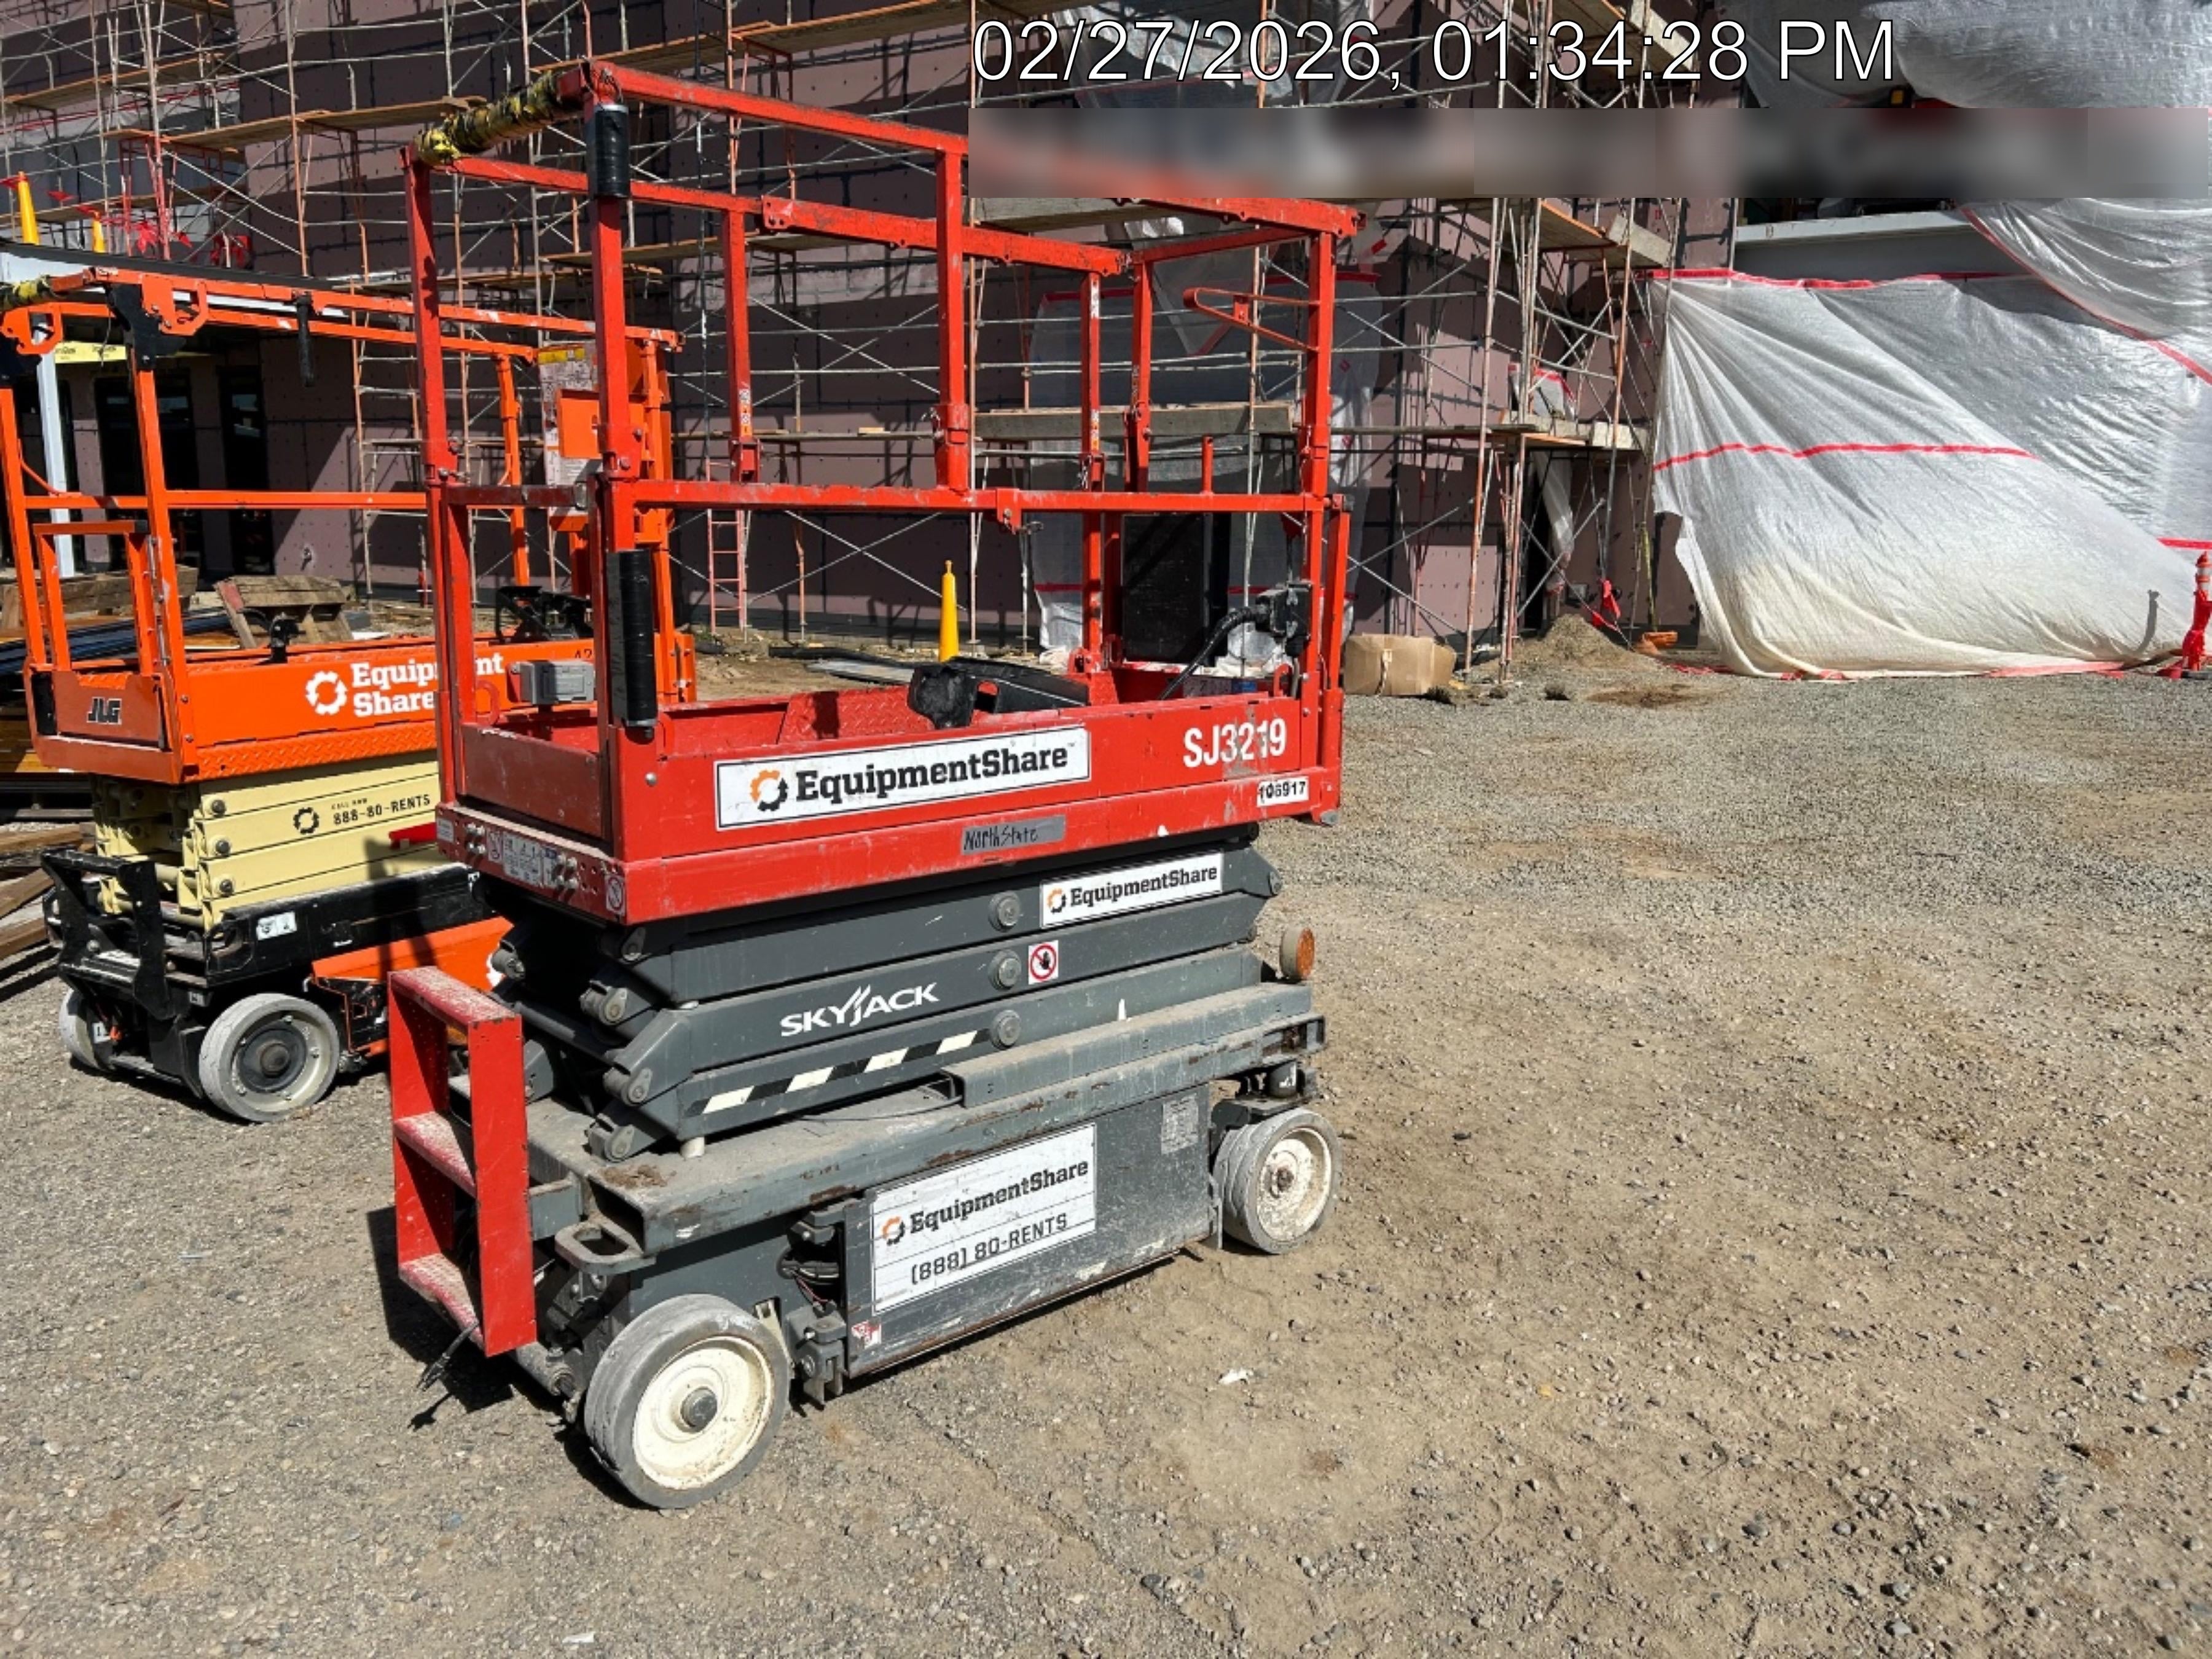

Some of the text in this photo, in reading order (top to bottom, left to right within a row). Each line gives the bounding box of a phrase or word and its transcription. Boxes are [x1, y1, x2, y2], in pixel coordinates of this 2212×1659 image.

[350, 651, 506, 691] Equipnt
[87, 696, 122, 725] JLG
[352, 690, 436, 719] Share
[1182, 718, 1287, 768] SJ3219
[796, 747, 1068, 804] EquipmentShare
[333, 794, 431, 826] 888-80-RENTS
[1070, 866, 1217, 908] EquipmentShare
[780, 982, 941, 1037] SKYJACK
[909, 1160, 1089, 1234] EquipmentShare
[974, 1212, 1068, 1261] 80-RENTS
